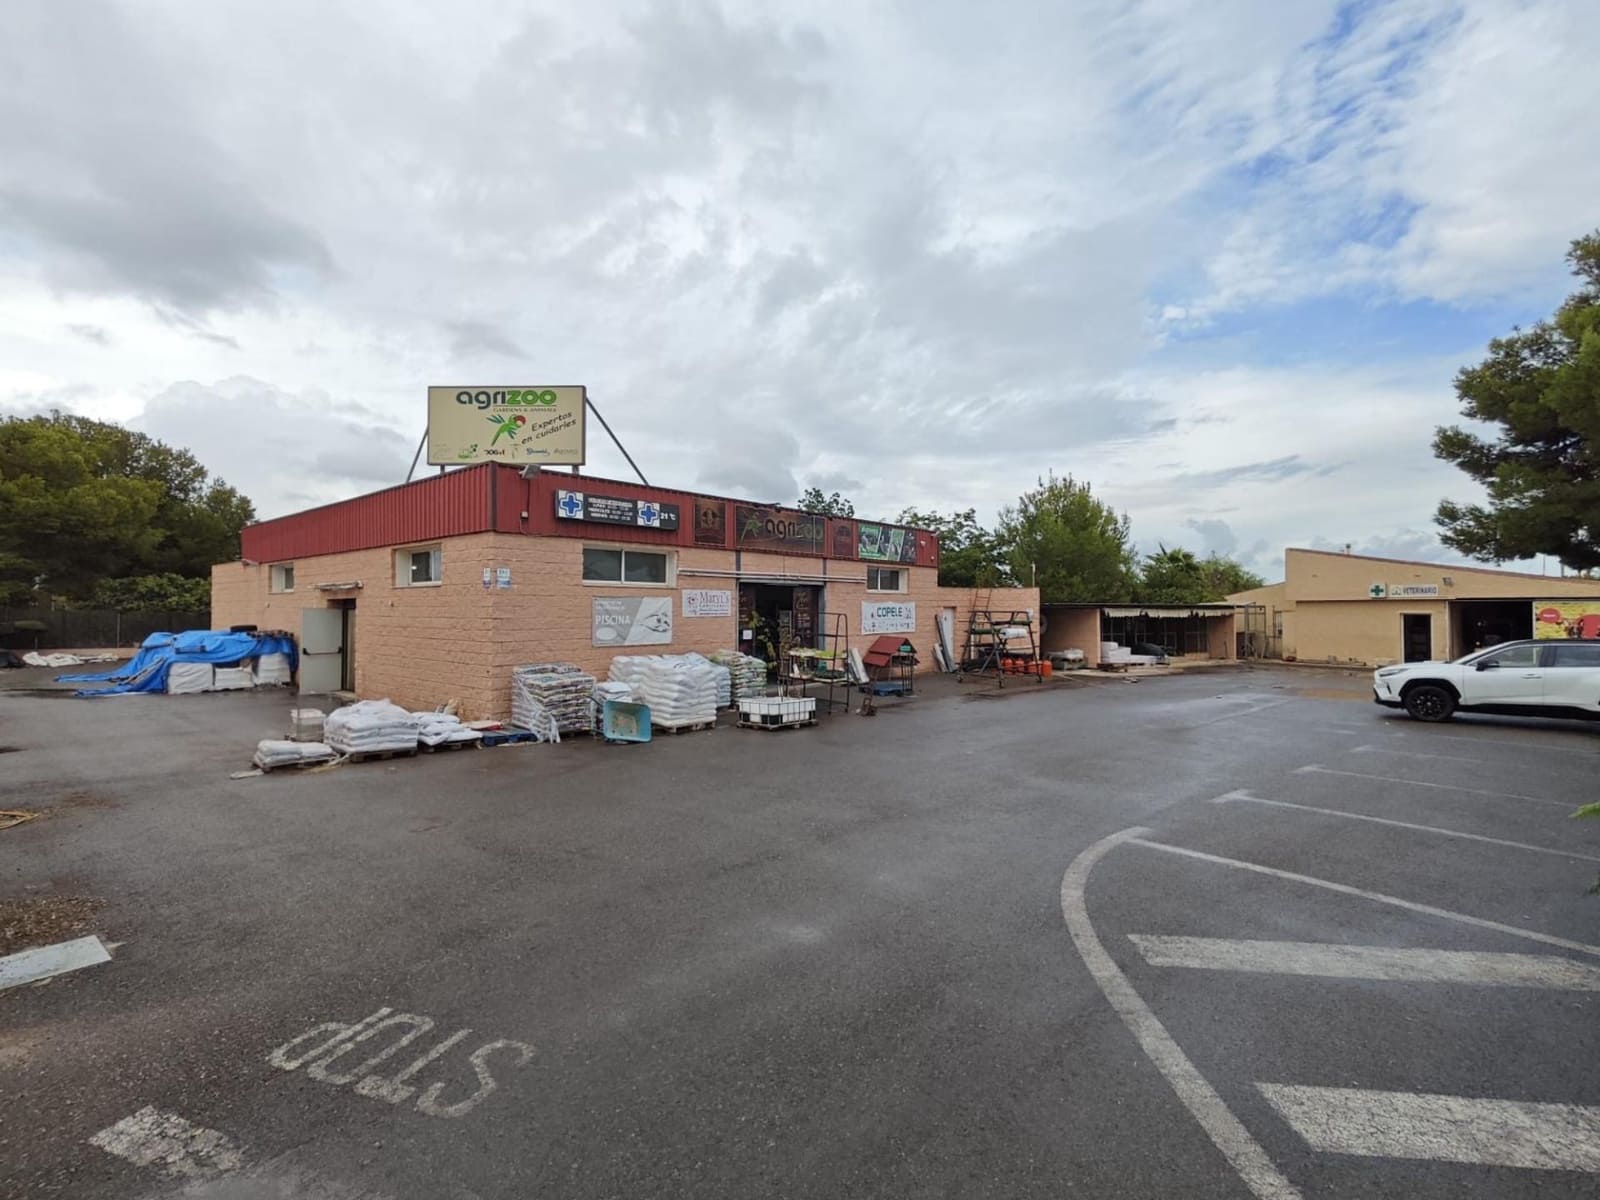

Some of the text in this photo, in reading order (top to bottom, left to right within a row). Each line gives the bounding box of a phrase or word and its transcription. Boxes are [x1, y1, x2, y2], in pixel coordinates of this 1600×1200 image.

[456, 389, 558, 410] agrizoo
[521, 419, 577, 445] en cuidarles
[531, 412, 573, 432] Expertos
[1402, 586, 1437, 594] VETERINARIO
[595, 615, 632, 625] PISCINA
[876, 606, 904, 618] COPELE
[265, 1007, 536, 1119] STOP
